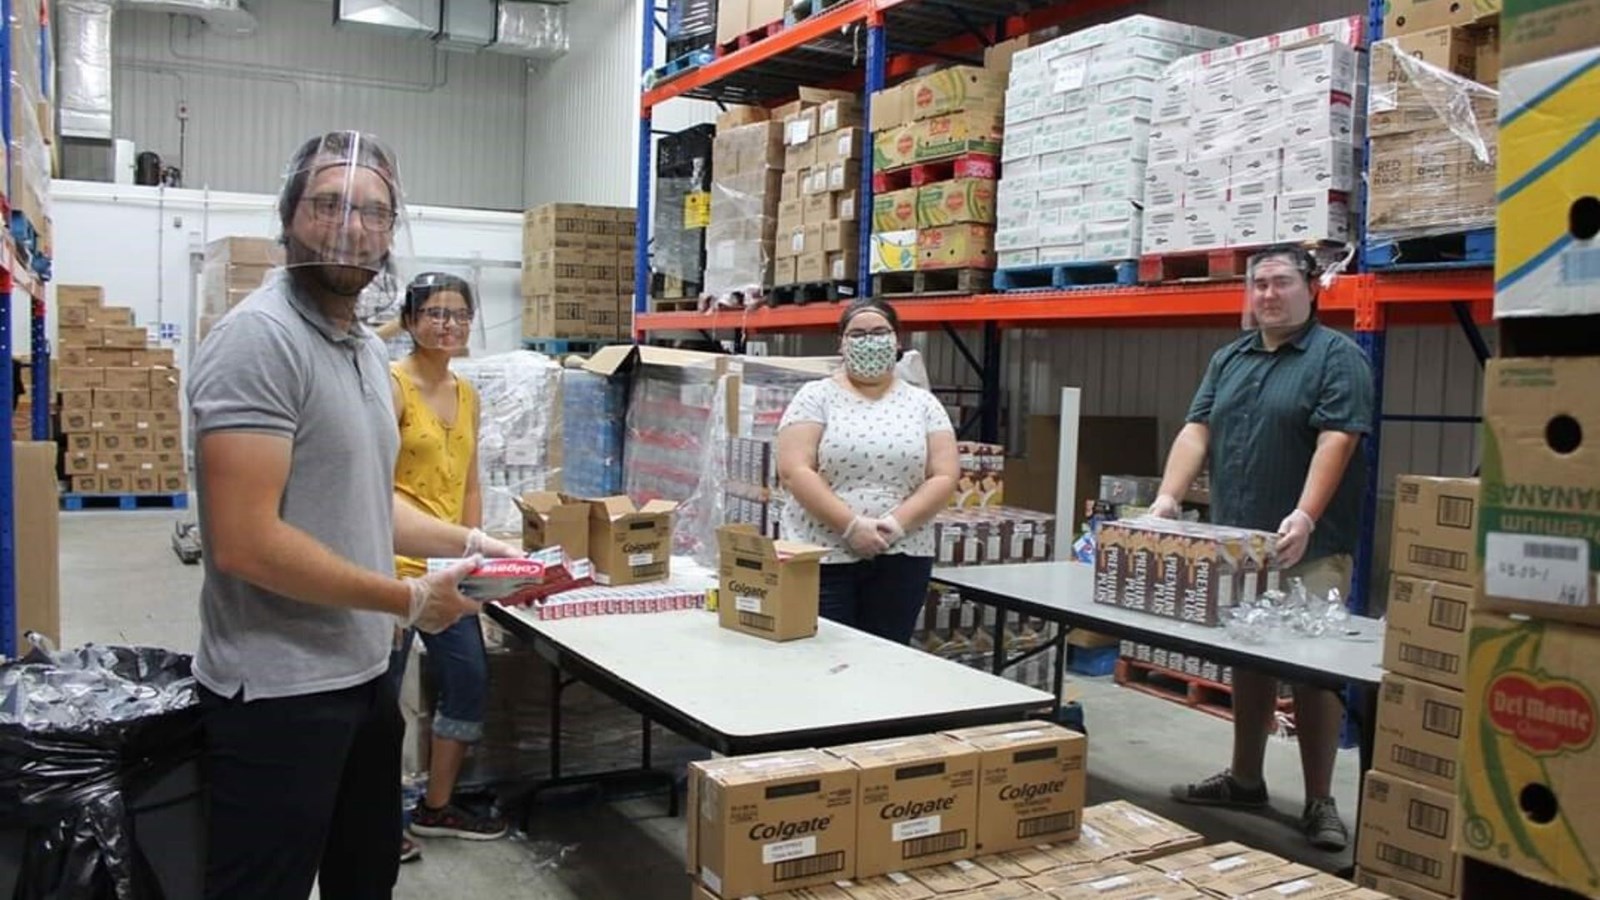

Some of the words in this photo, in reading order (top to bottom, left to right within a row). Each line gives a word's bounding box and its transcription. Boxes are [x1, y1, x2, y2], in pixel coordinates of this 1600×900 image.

[482, 563, 540, 575] Colgate
[1107, 547, 1118, 603] PREMIUM
[1135, 552, 1147, 609] PREMIUM
[728, 580, 769, 599] Colgate
[1097, 572, 1108, 602] PLUS
[1123, 577, 1136, 608] PLUS
[1154, 583, 1165, 614] PLUS
[1164, 557, 1177, 615] PREMIUM
[1195, 563, 1208, 622] PREMIUM
[1184, 589, 1196, 620] PLUS
[1493, 690, 1524, 716] Del
[1525, 697, 1590, 732] Monte
[999, 780, 1065, 804] Colgate
[880, 796, 955, 820] Colgate
[749, 817, 831, 841] Colgate
